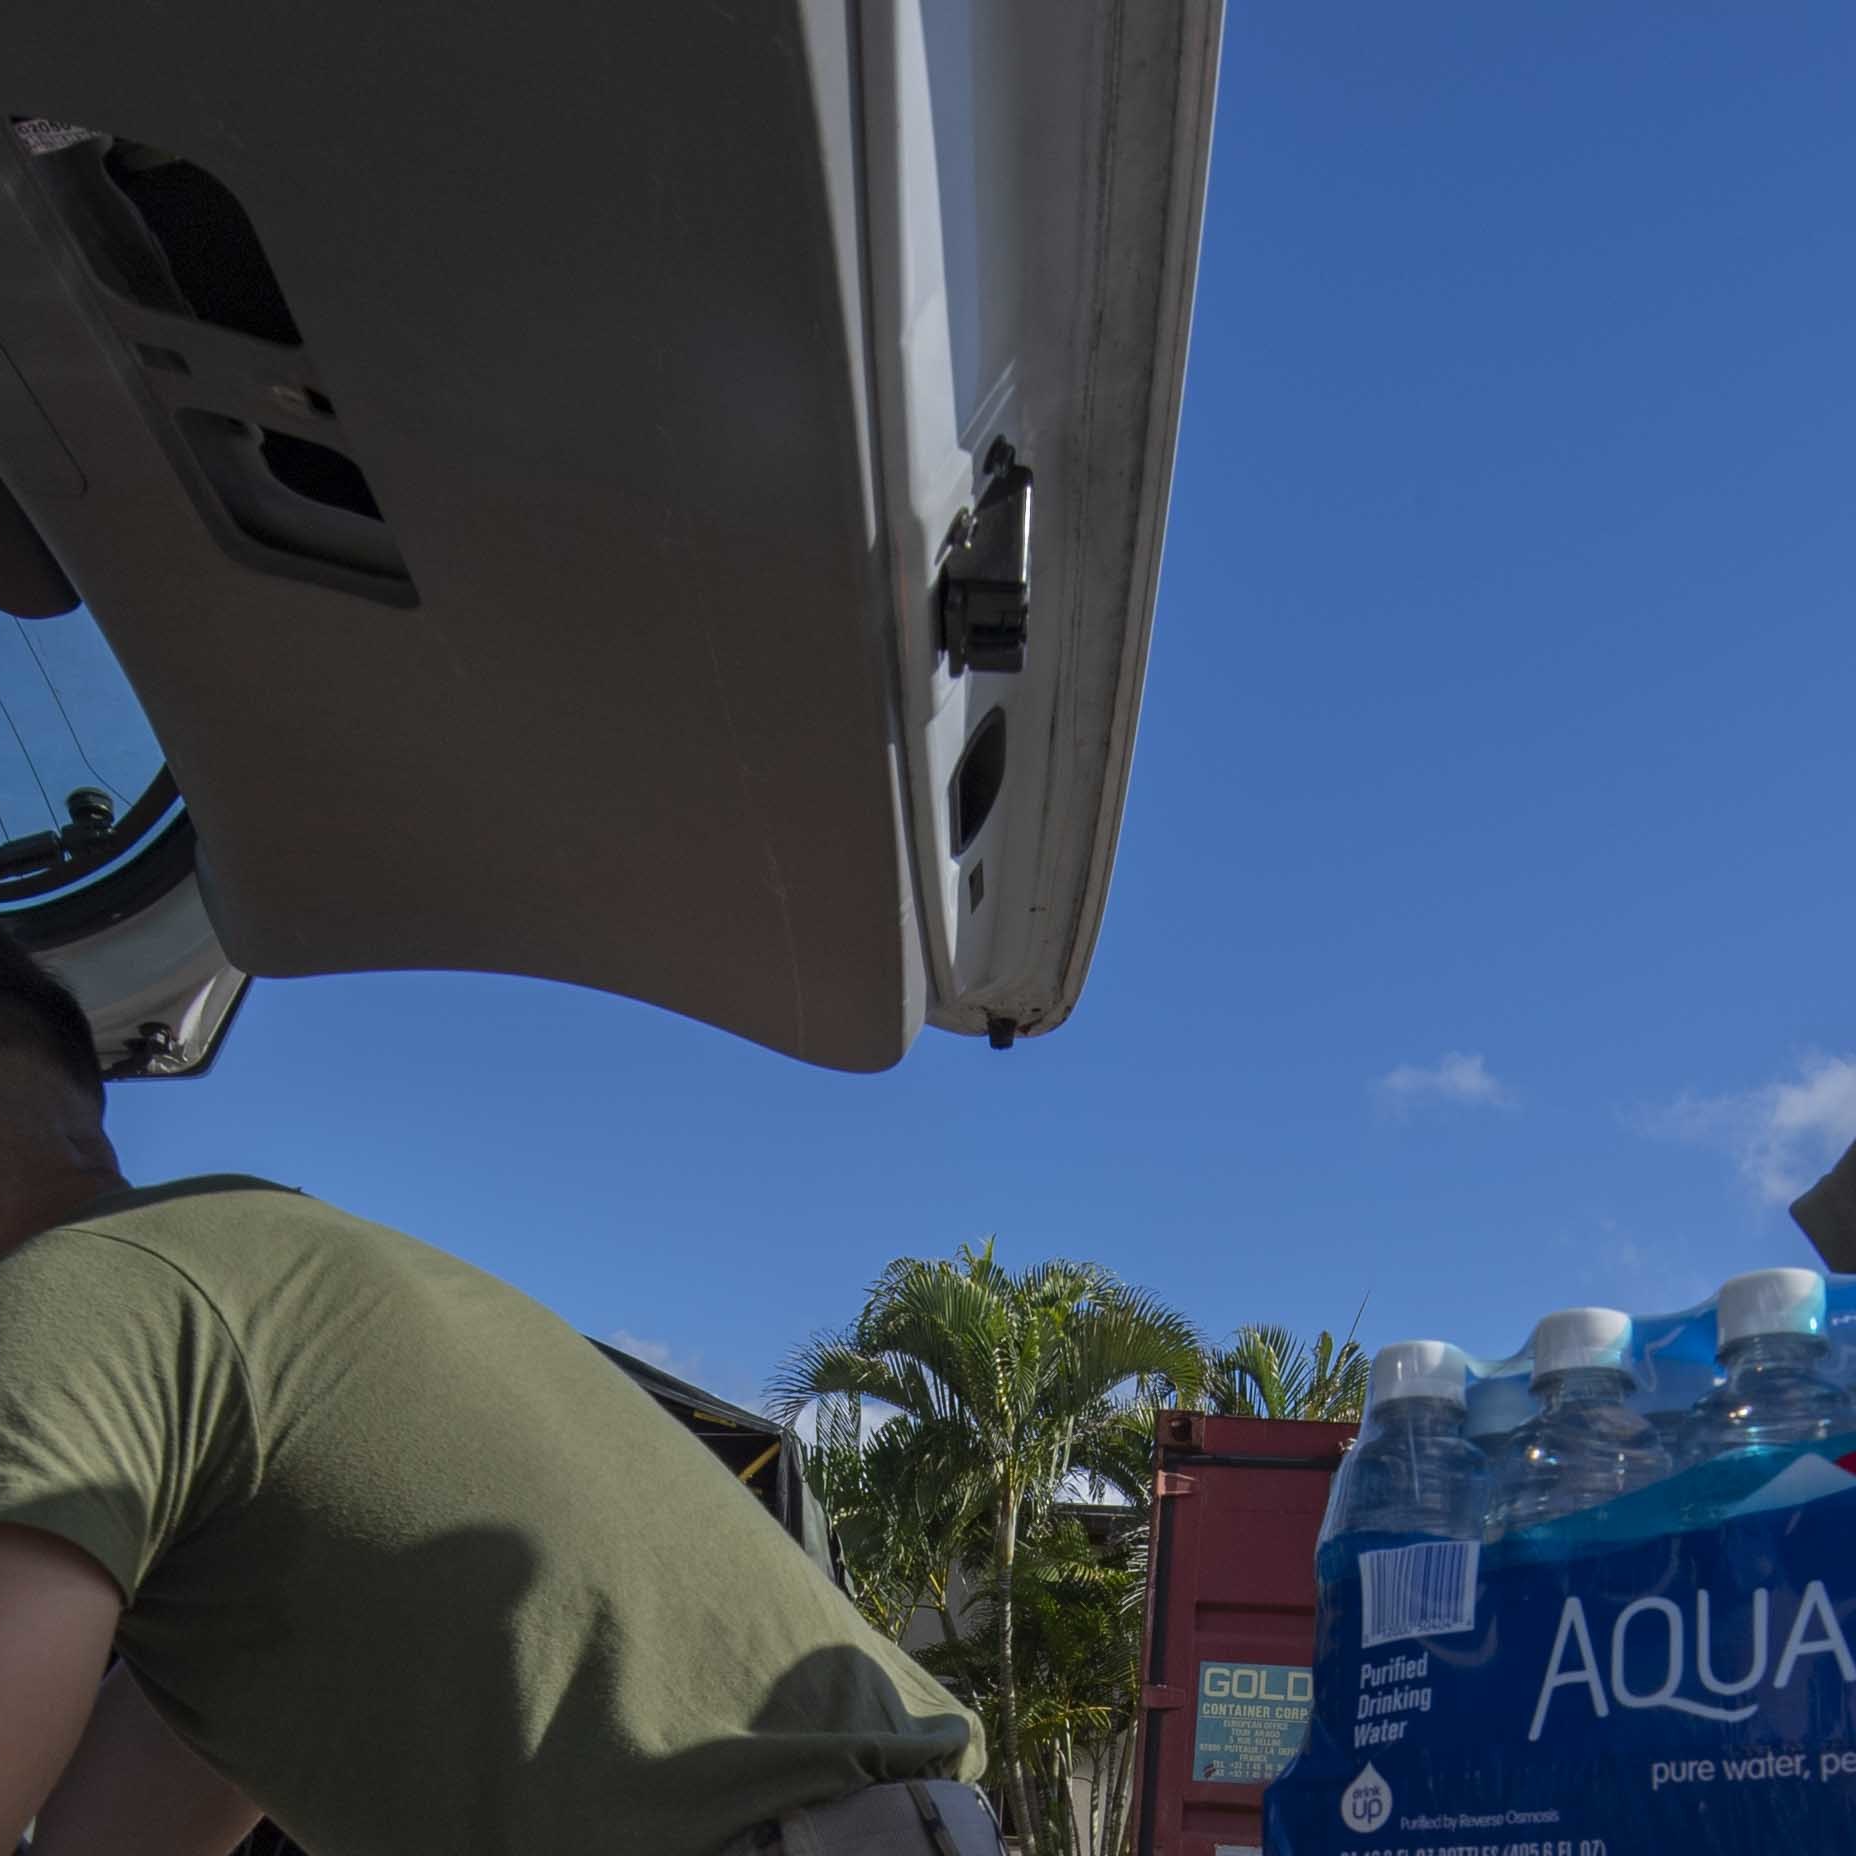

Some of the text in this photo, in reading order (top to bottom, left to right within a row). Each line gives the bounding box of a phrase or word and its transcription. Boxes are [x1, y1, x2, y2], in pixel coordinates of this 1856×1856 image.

[1204, 1667, 1313, 1701] GOLD
[1359, 1651, 1429, 1690] Purified
[1203, 1703, 1270, 1719] CONTAINER
[1356, 1686, 1432, 1720] Drinking
[1353, 1719, 1408, 1749] Water
[1651, 1757, 1716, 1791] pure
[1722, 1751, 1812, 1782] water,
[1352, 1784, 1382, 1800] drink
[1352, 1799, 1383, 1825] up
